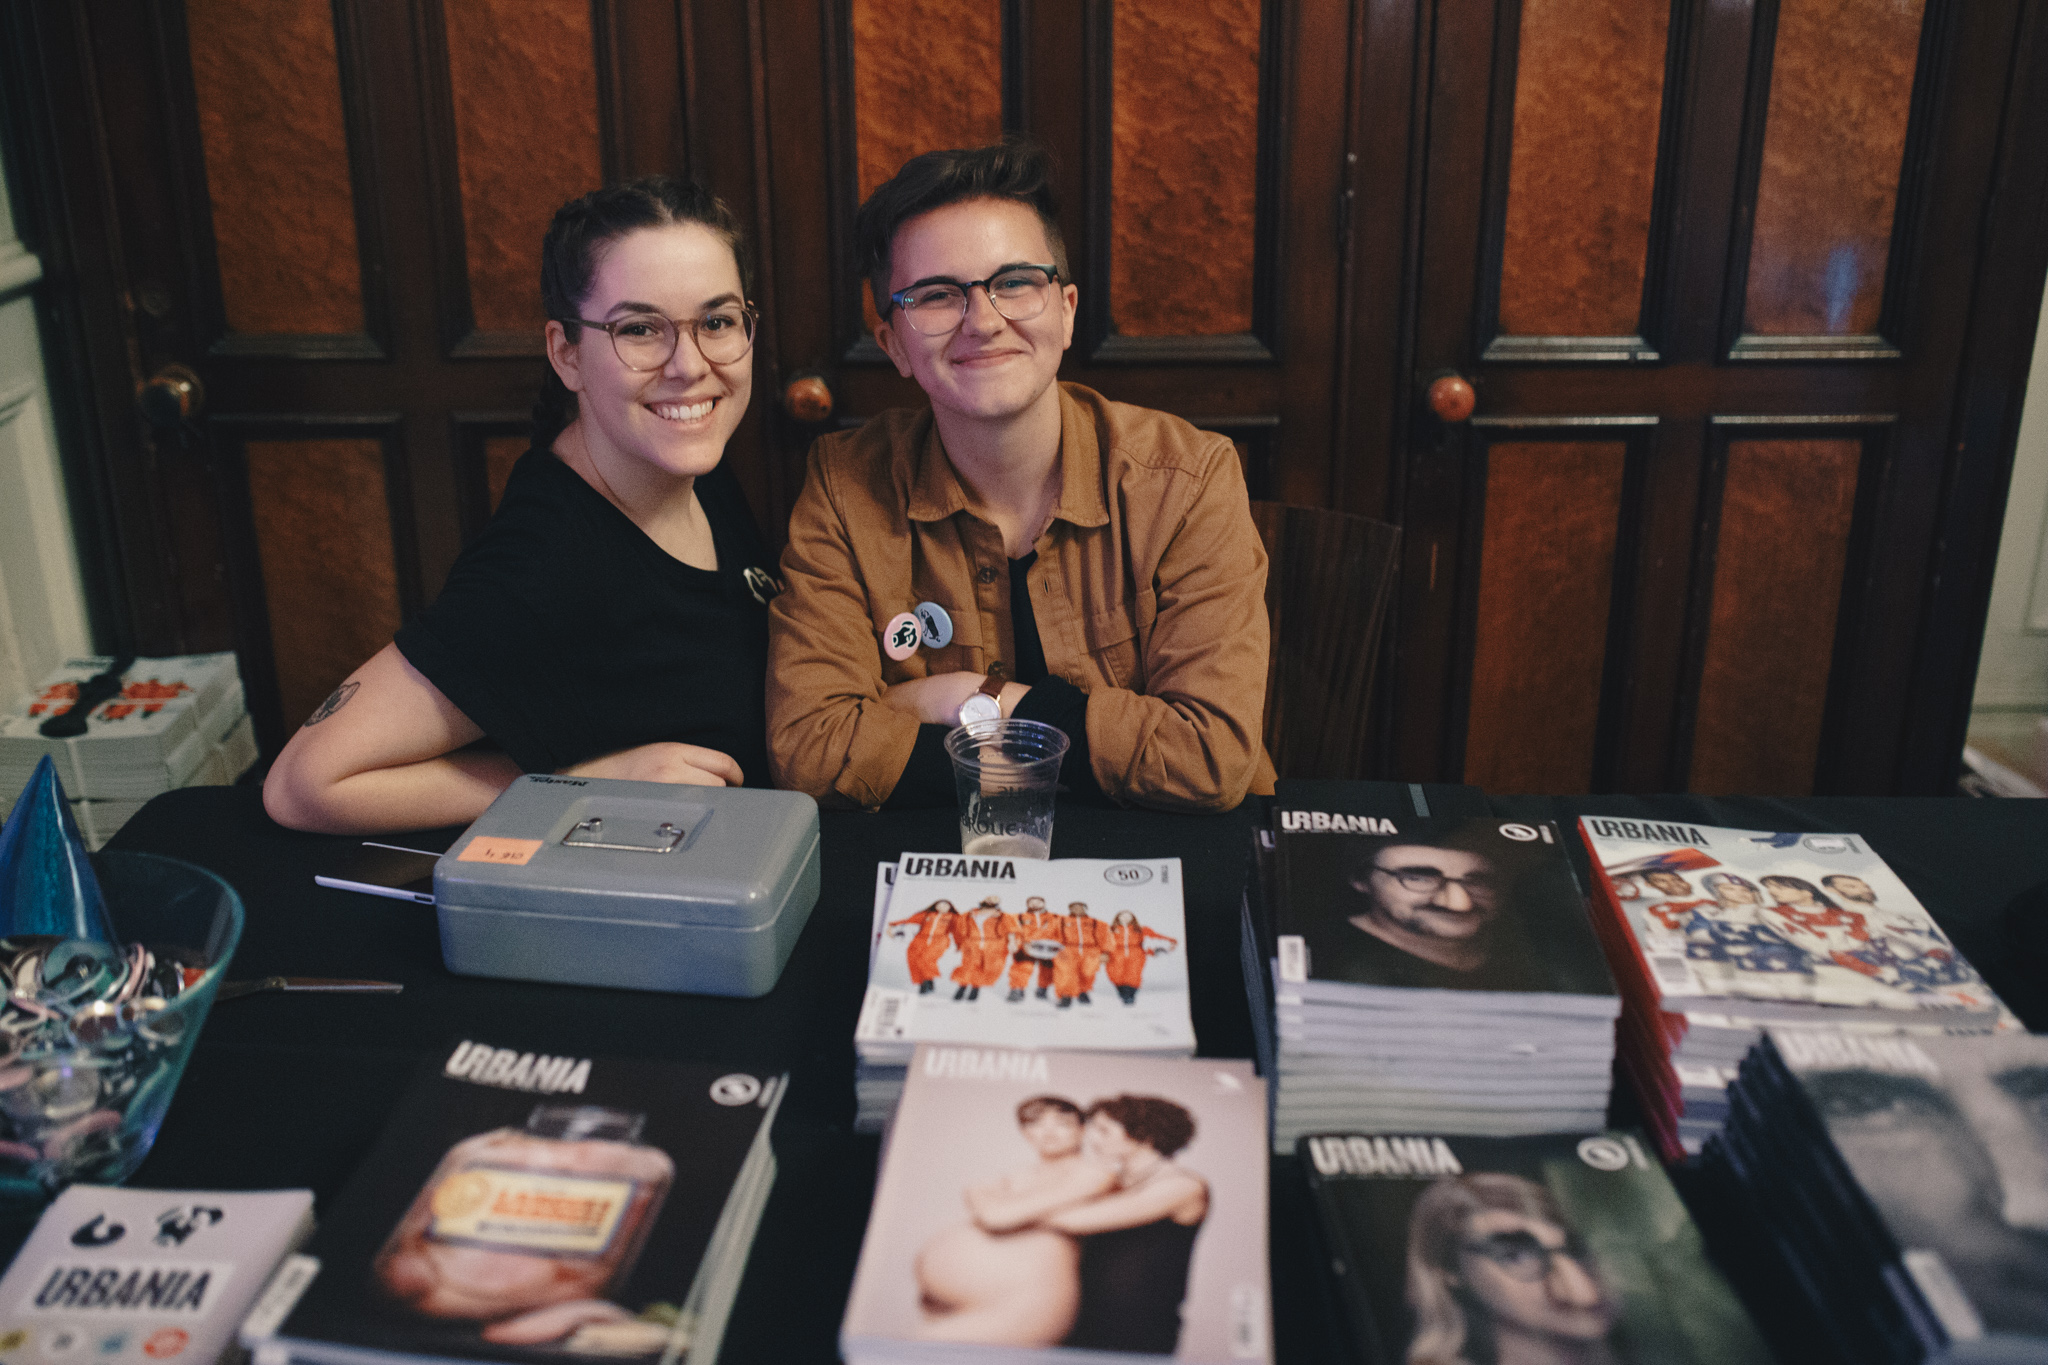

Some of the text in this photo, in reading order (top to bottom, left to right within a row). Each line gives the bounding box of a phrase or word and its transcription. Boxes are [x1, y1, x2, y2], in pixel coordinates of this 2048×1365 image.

[1281, 810, 1398, 834] URBANIA
[1591, 818, 1710, 846] URBANIA
[904, 856, 1017, 880] URBANIA
[1117, 868, 1140, 881] 50
[444, 1040, 592, 1095] URBANIA
[1308, 1136, 1464, 1176] URBANIA
[34, 1265, 214, 1312] URBANIA
